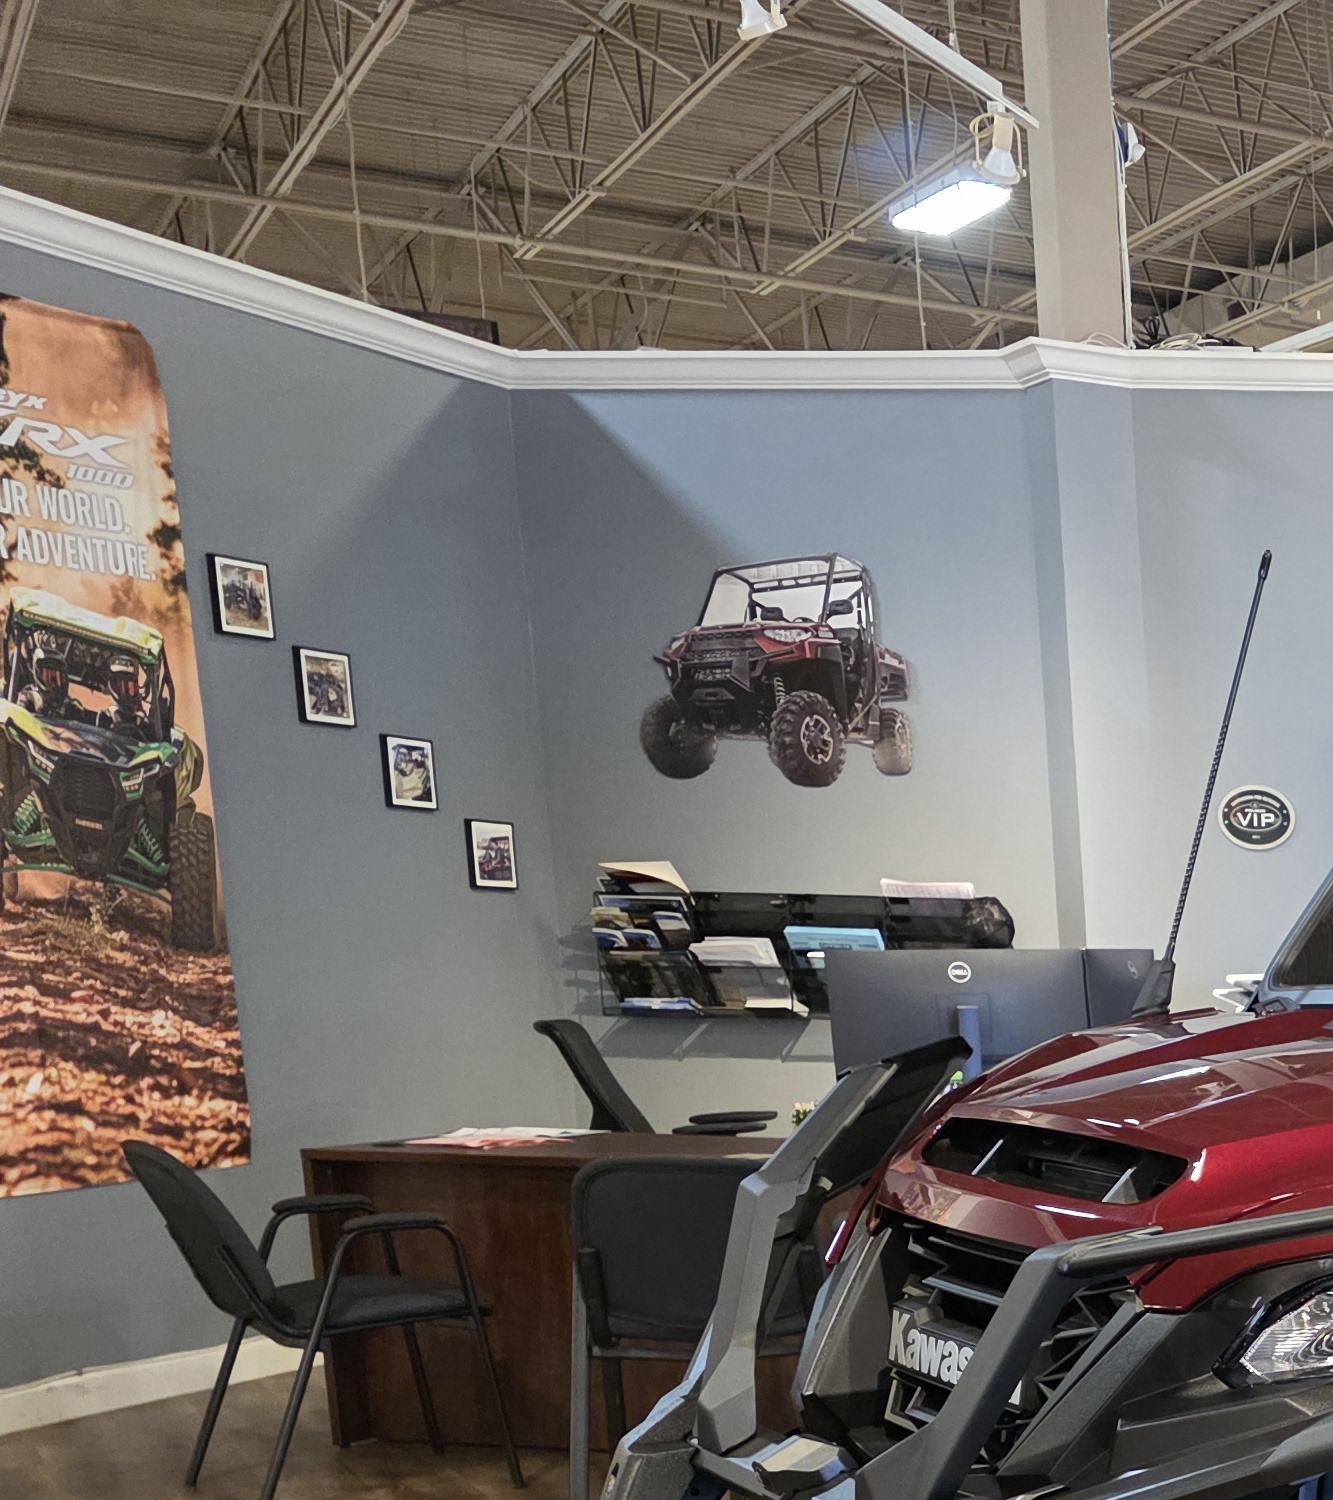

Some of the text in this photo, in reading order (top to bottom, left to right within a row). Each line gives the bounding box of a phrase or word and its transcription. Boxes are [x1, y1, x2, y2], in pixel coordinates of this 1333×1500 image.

[67, 464, 134, 488] 1000
[36, 484, 132, 535] WORLD.
[17, 526, 157, 581] ADVENTURE.
[1236, 811, 1276, 828] VIP
[888, 1309, 976, 1385] Kawas
